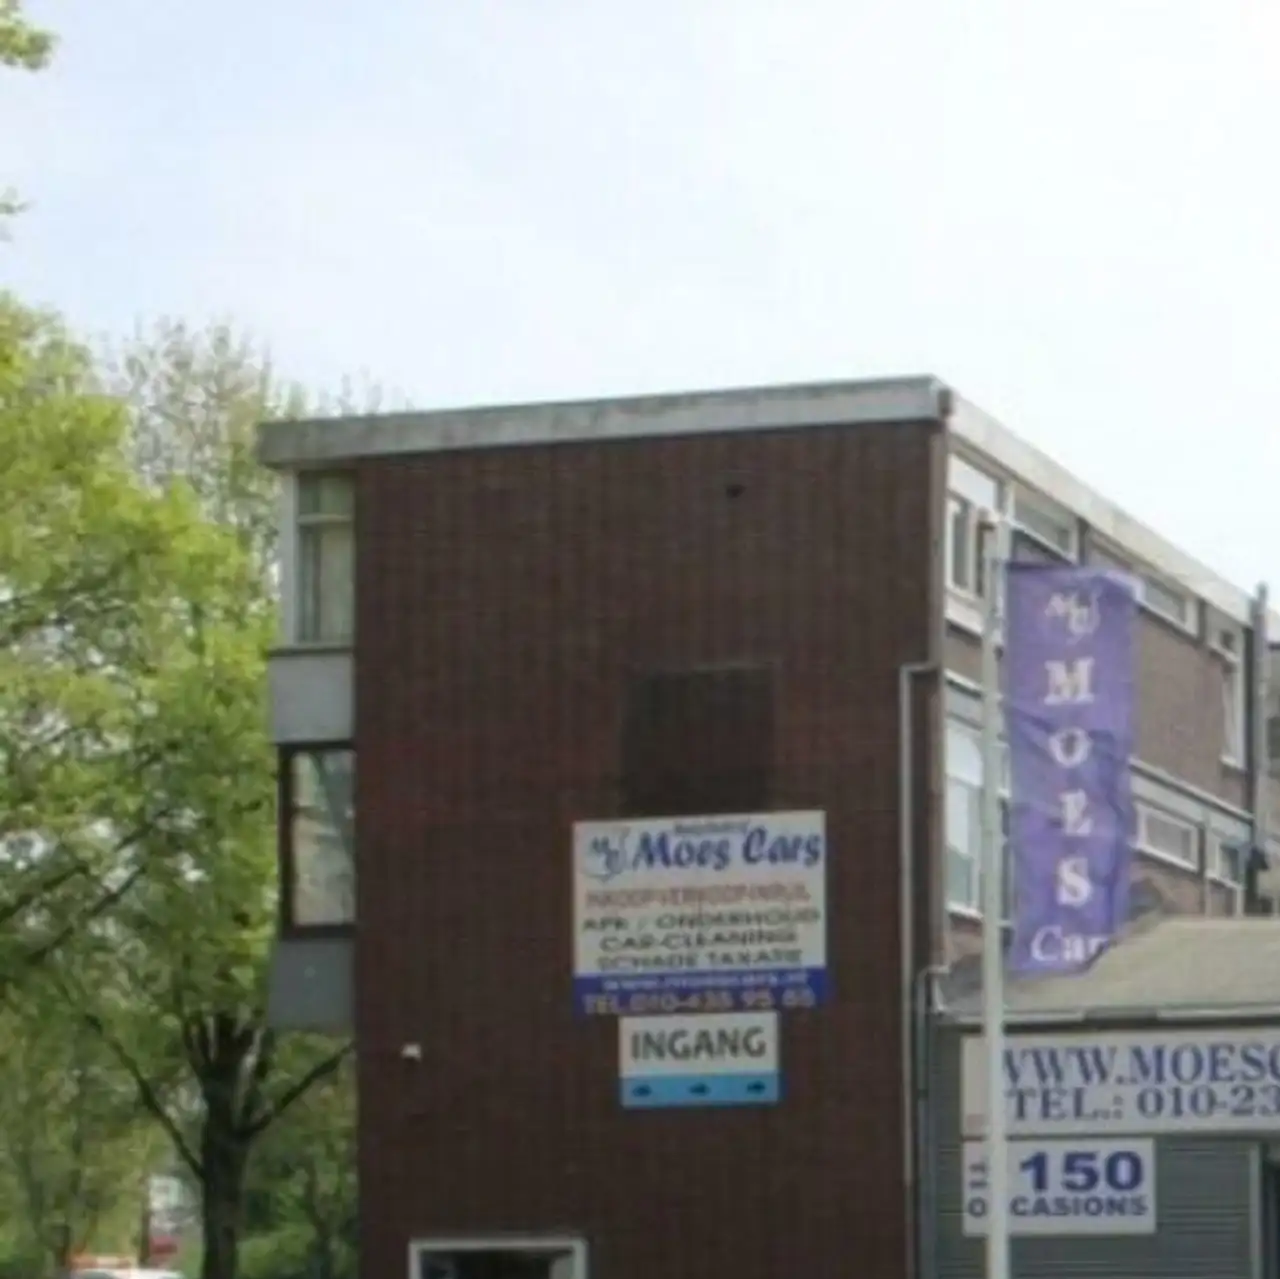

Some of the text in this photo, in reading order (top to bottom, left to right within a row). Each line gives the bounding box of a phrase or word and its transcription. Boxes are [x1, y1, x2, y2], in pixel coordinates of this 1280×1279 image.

[630, 826, 823, 871] Moes Cars
[1029, 925, 1110, 963] Car
[630, 1027, 767, 1061] INGANG
[1019, 1150, 1145, 1191] 150
[967, 1196, 1149, 1218] OCASIONS
